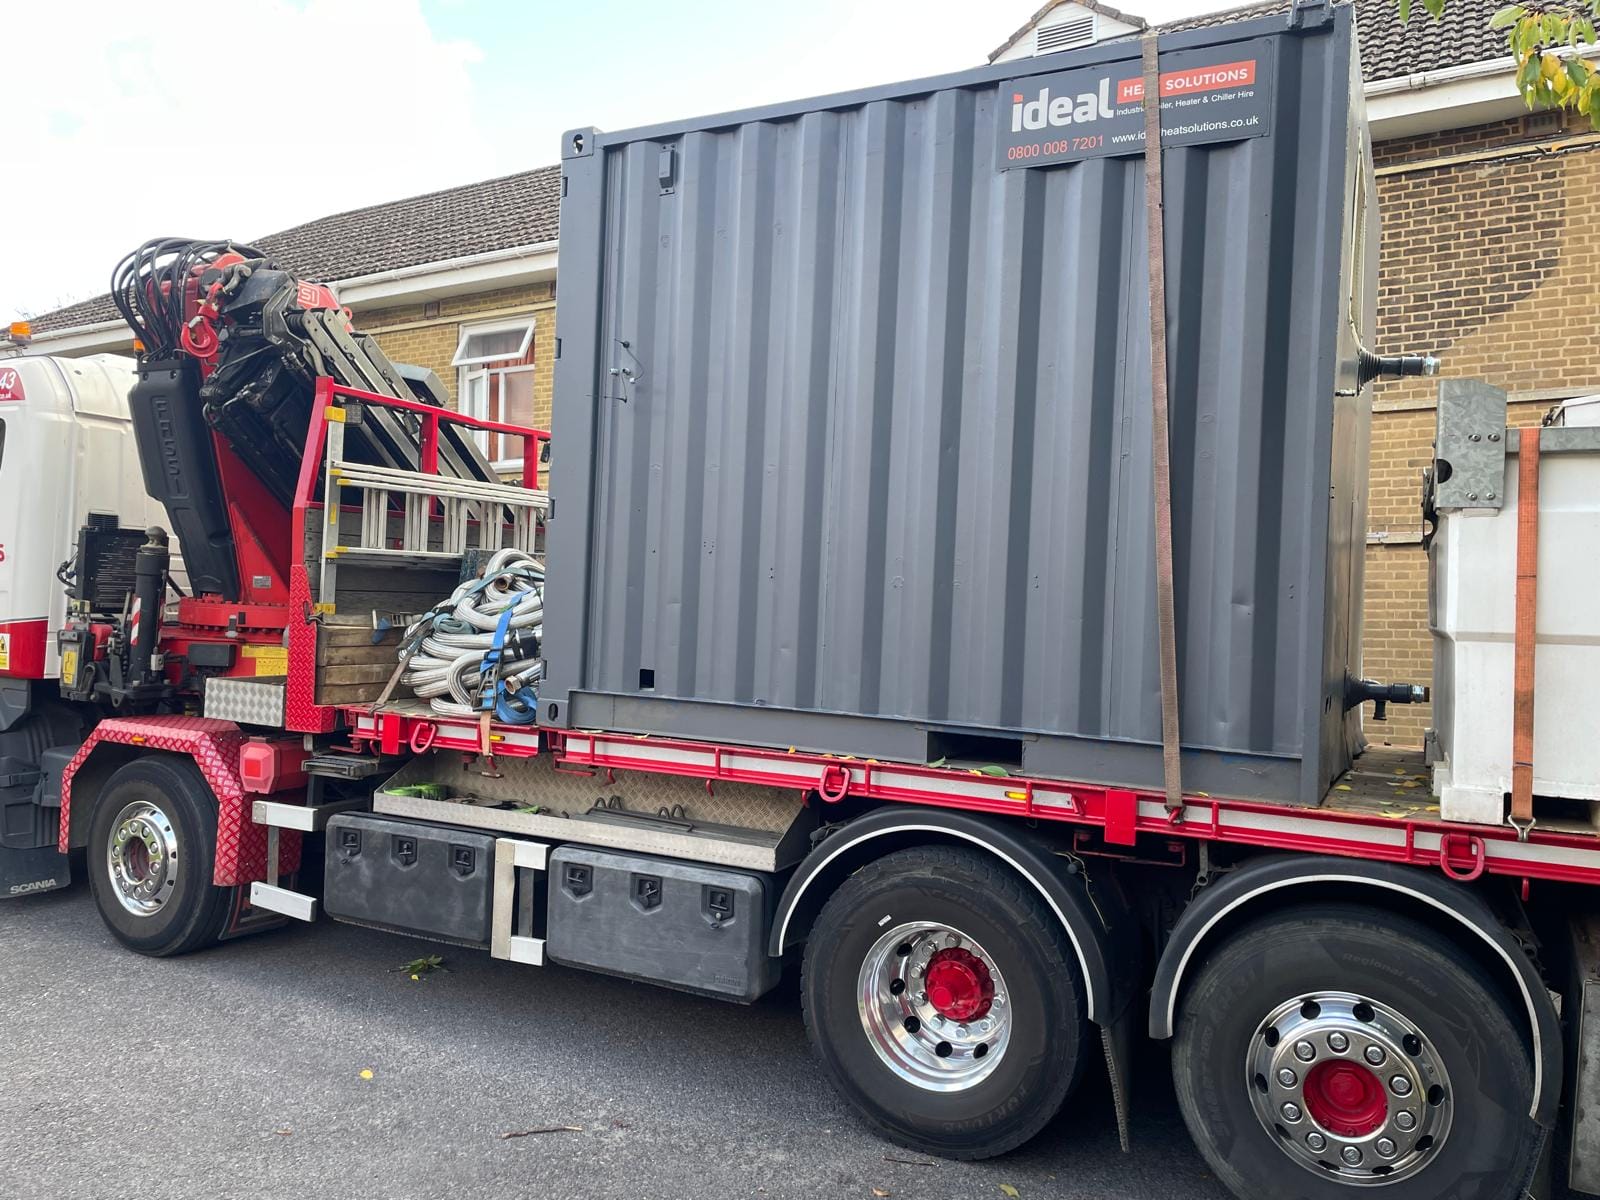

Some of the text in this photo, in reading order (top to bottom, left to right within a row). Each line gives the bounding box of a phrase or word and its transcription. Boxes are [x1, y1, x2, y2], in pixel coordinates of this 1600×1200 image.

[1123, 68, 1248, 97] HE SOLUTIONS
[1011, 77, 1114, 132] ideal
[1175, 98, 1201, 107] Heater
[1202, 95, 1209, 104] &
[1211, 93, 1236, 103] Chiller
[1237, 90, 1254, 99] Hire
[1112, 115, 1259, 143] www.idheatsolutions.co.uk
[1008, 134, 1104, 160] 0800 008 7201
[10, 878, 57, 894] SCANIA
